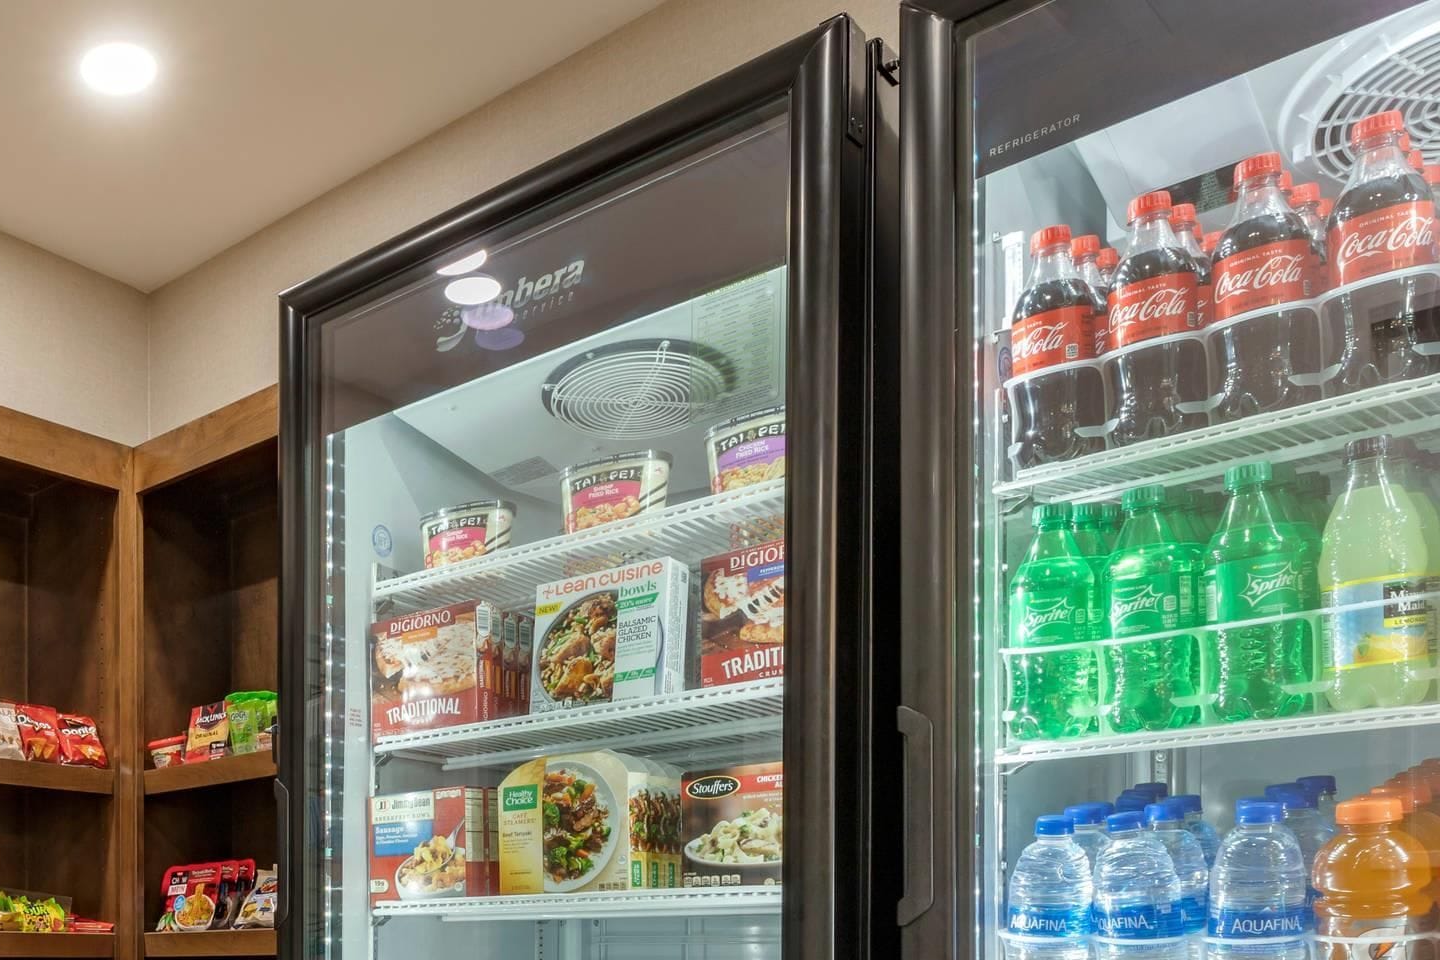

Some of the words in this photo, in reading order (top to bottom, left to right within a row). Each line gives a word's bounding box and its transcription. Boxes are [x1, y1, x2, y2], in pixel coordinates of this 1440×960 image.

[988, 113, 1081, 157] REFRIGERATOR
[1336, 216, 1434, 269] Coca-Cola
[1215, 254, 1305, 304] Coca-Cola
[1109, 287, 1191, 334] Coca-Cola
[720, 432, 744, 451] TAI
[575, 475, 597, 491] TAI
[609, 469, 635, 481] PEI
[618, 580, 657, 598] bowls
[1250, 573, 1293, 595] Sprite
[1111, 595, 1155, 618] Sprite
[618, 615, 657, 630] BALSAMIC
[1026, 607, 1069, 626] Sprite
[618, 625, 648, 637] GLAZED
[618, 631, 652, 643] CHICKEN
[758, 669, 784, 678] CRUS
[386, 697, 461, 725] TRADITIONAL
[691, 779, 734, 795] Stouffer's
[505, 797, 534, 806] Choice
[1097, 914, 1148, 930] QUAFINA
[1231, 915, 1301, 935] AQUAFINA
